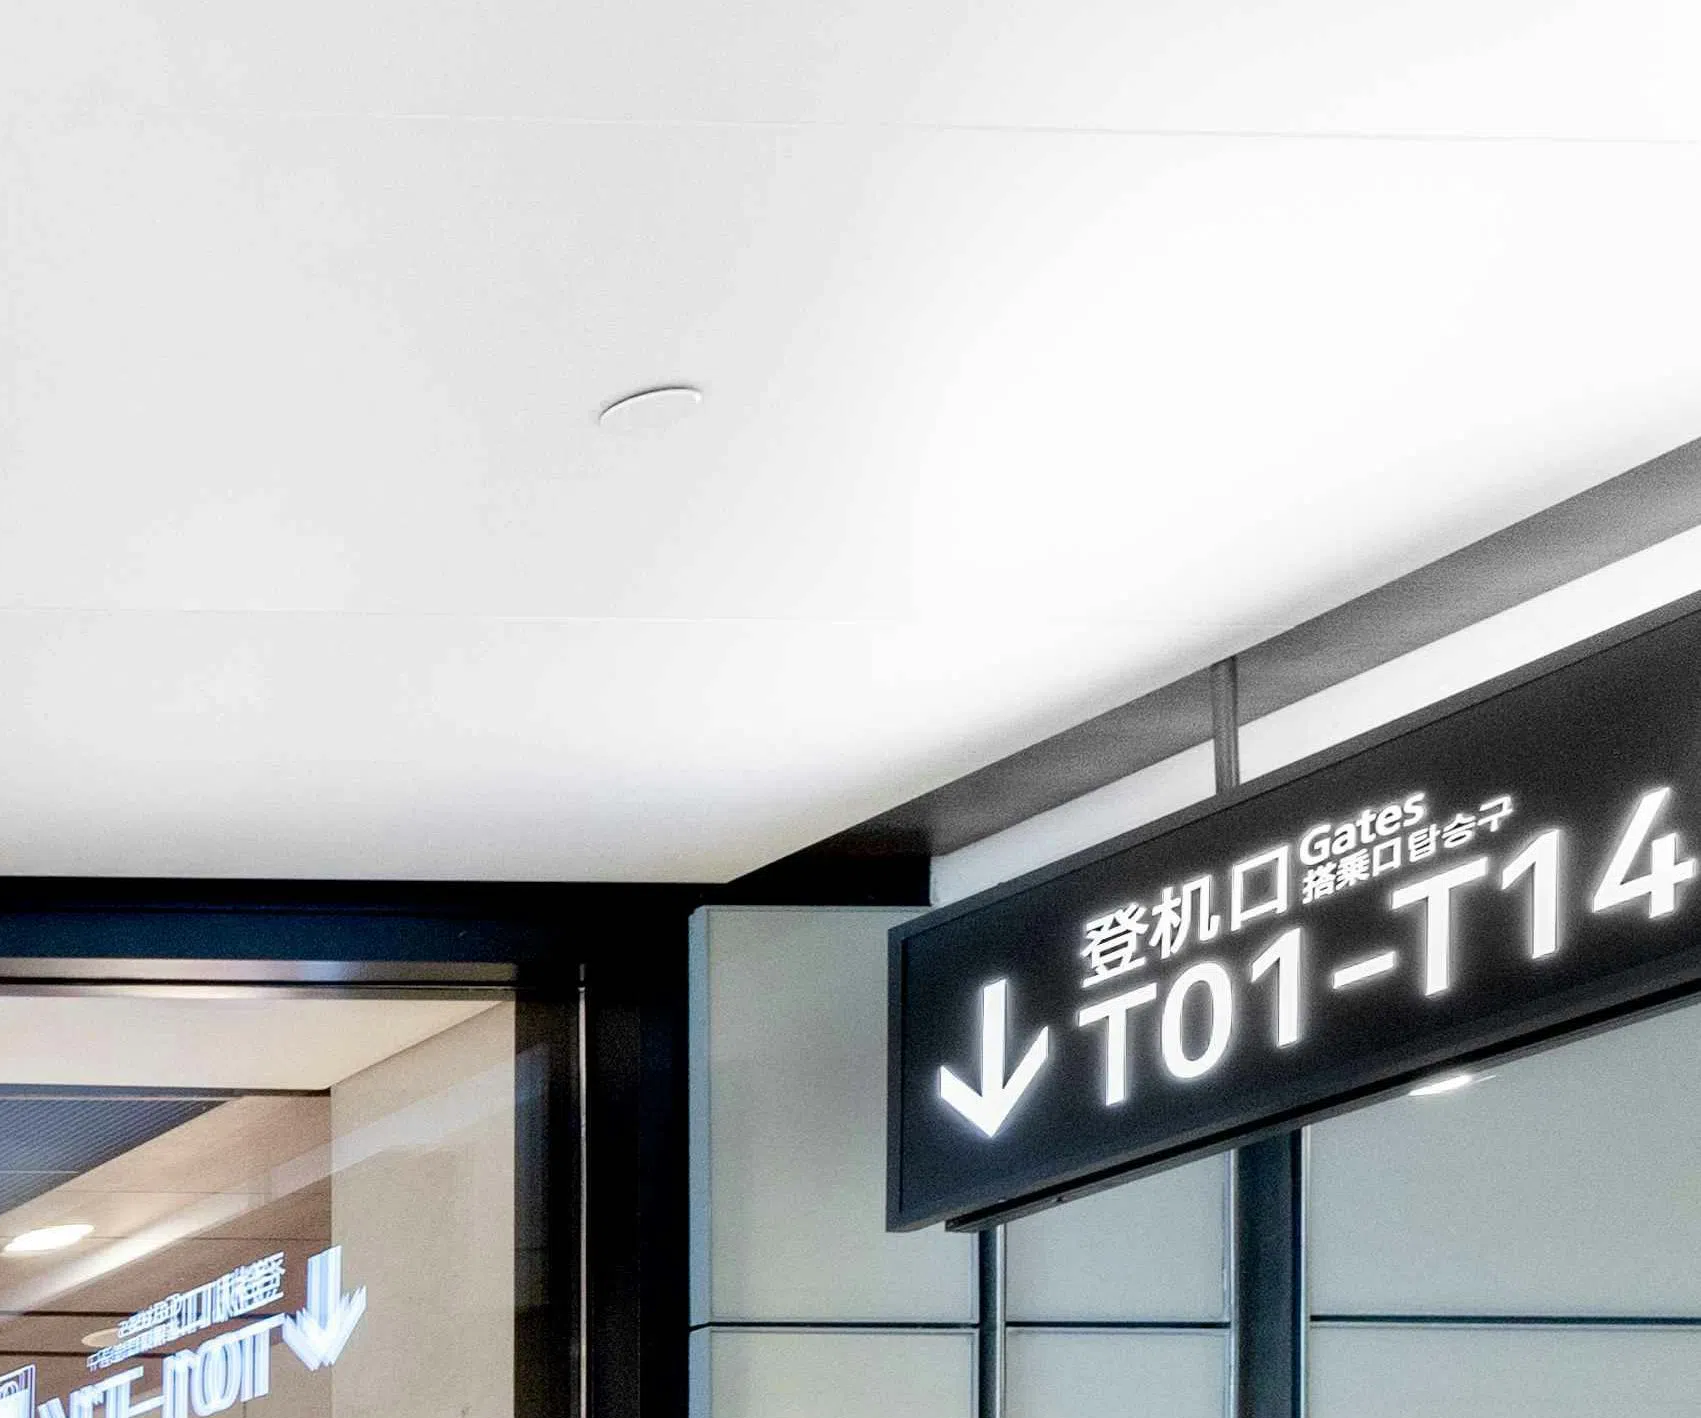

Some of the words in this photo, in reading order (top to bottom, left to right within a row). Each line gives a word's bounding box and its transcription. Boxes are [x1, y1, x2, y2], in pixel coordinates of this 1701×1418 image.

[1299, 792, 1426, 866] Gates
[1407, 795, 1514, 863] 탑승구
[1077, 786, 1701, 1107] T01-T14
[1081, 844, 1291, 989] 登机口
